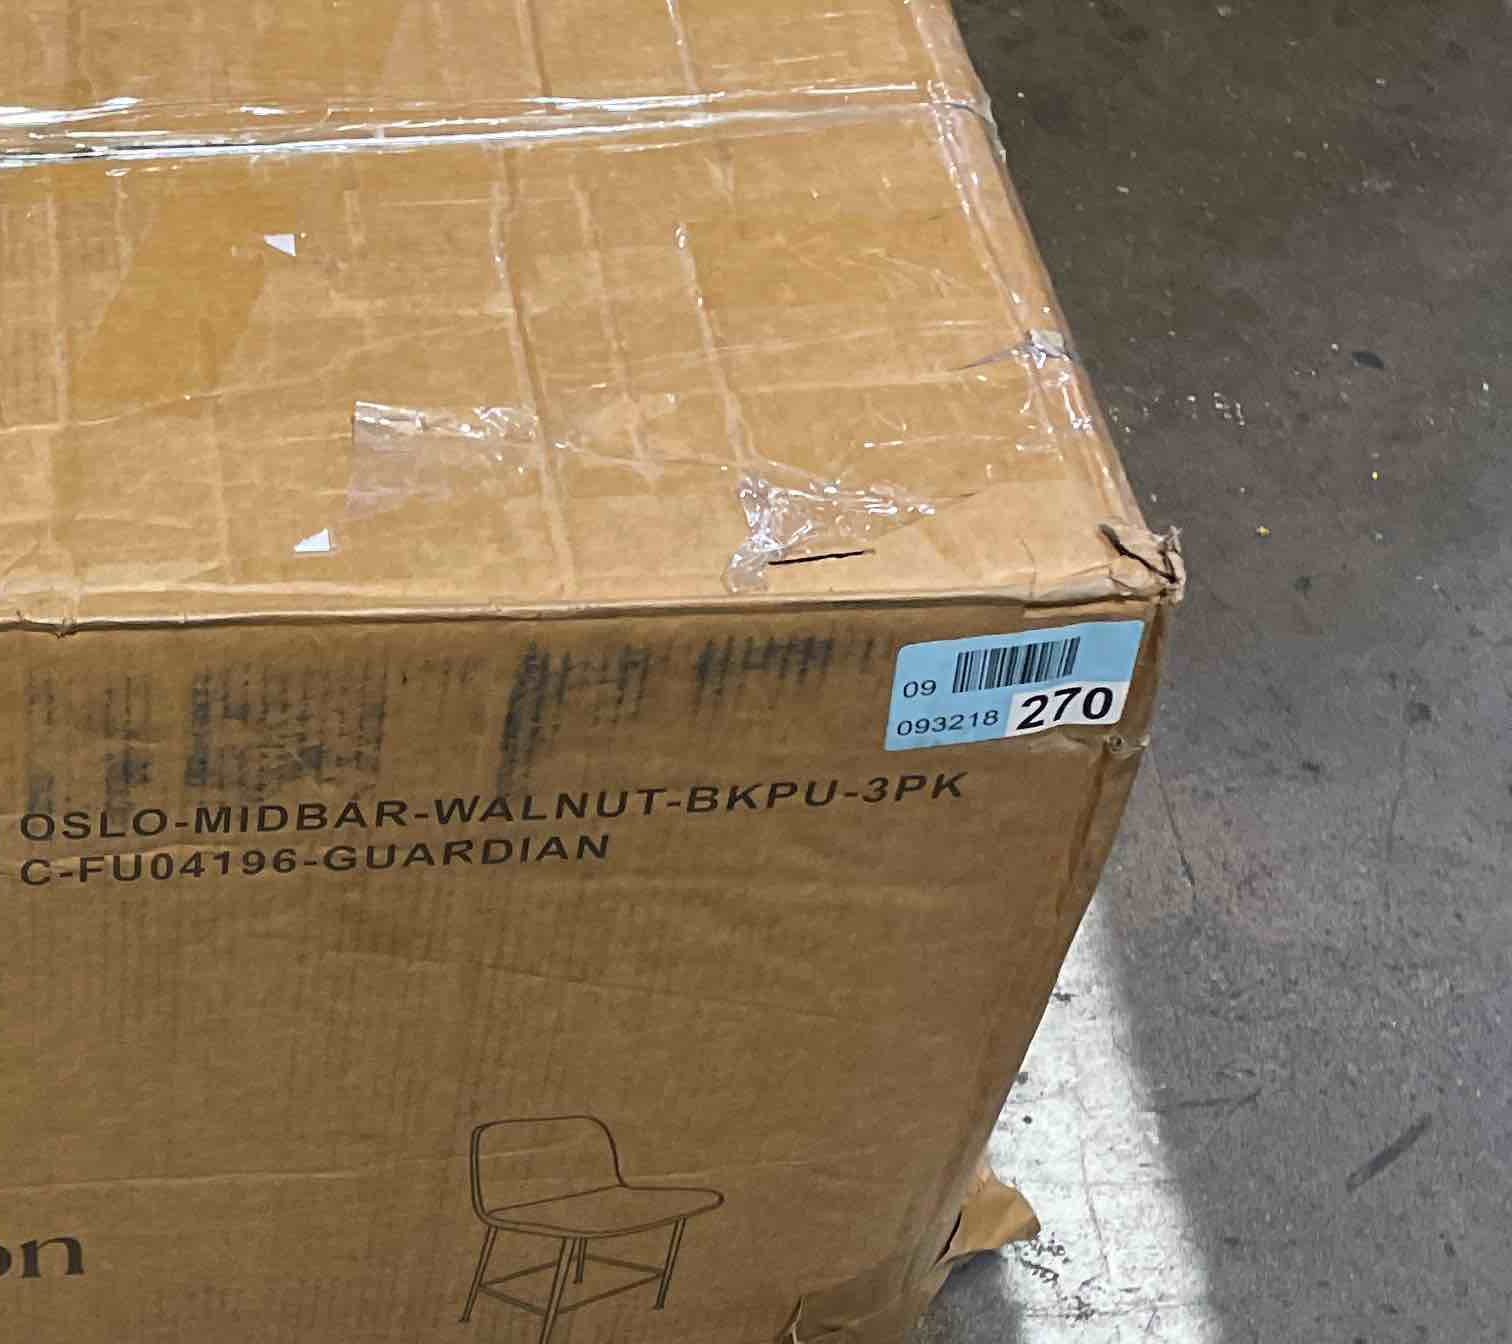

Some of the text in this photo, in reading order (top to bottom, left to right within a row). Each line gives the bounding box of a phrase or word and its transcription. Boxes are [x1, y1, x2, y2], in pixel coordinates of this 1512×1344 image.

[903, 680, 936, 698] 09
[1016, 687, 1113, 731] 270
[897, 710, 999, 736] 093218
[19, 771, 968, 841] OSLO-MIDBAR-WALNUT-BKPU-3PK
[19, 834, 609, 886] C-FU04196-GUARDIAN
